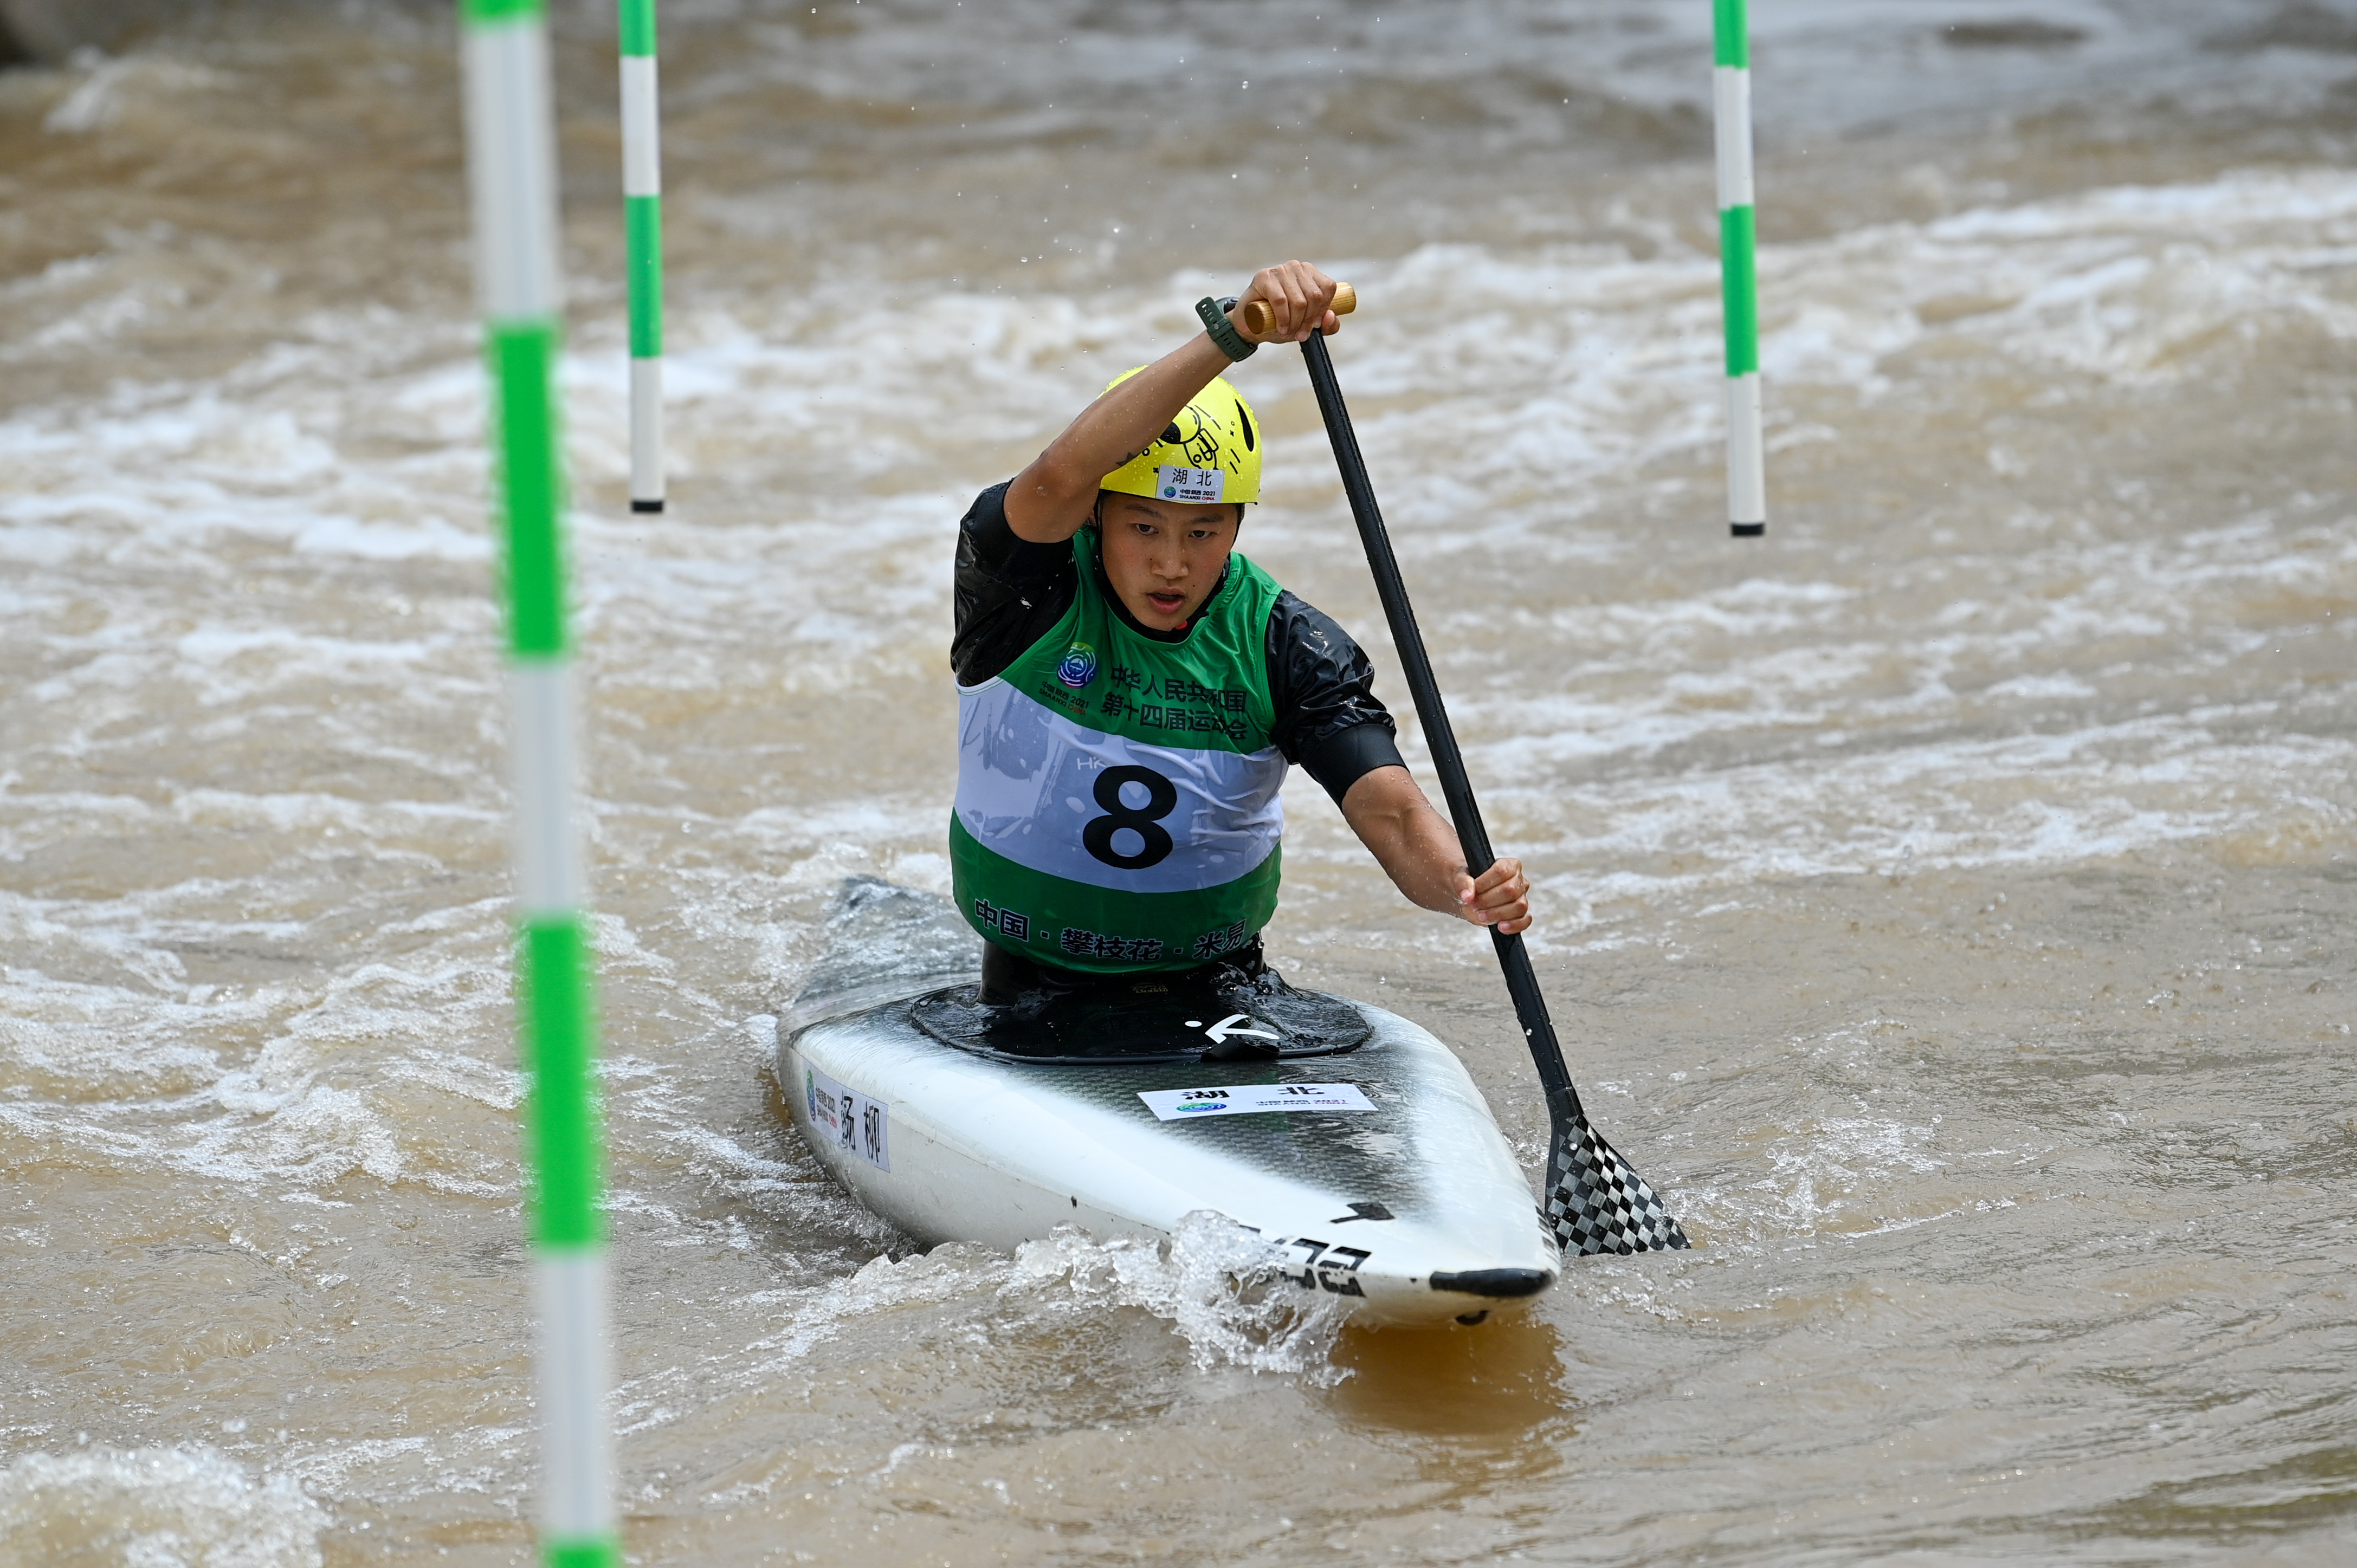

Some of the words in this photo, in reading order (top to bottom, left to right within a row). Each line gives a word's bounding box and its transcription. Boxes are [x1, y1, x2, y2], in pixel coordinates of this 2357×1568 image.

[1172, 468, 1212, 486] 湖北
[1038, 688, 1067, 707] SHAANXI
[1111, 664, 1247, 712] 中华人民共和国
[1070, 696, 1089, 709] 2021
[1100, 691, 1247, 740] 第十四届运动会
[1082, 764, 1177, 870] 8
[1180, 1086, 1325, 1100] 湖北
